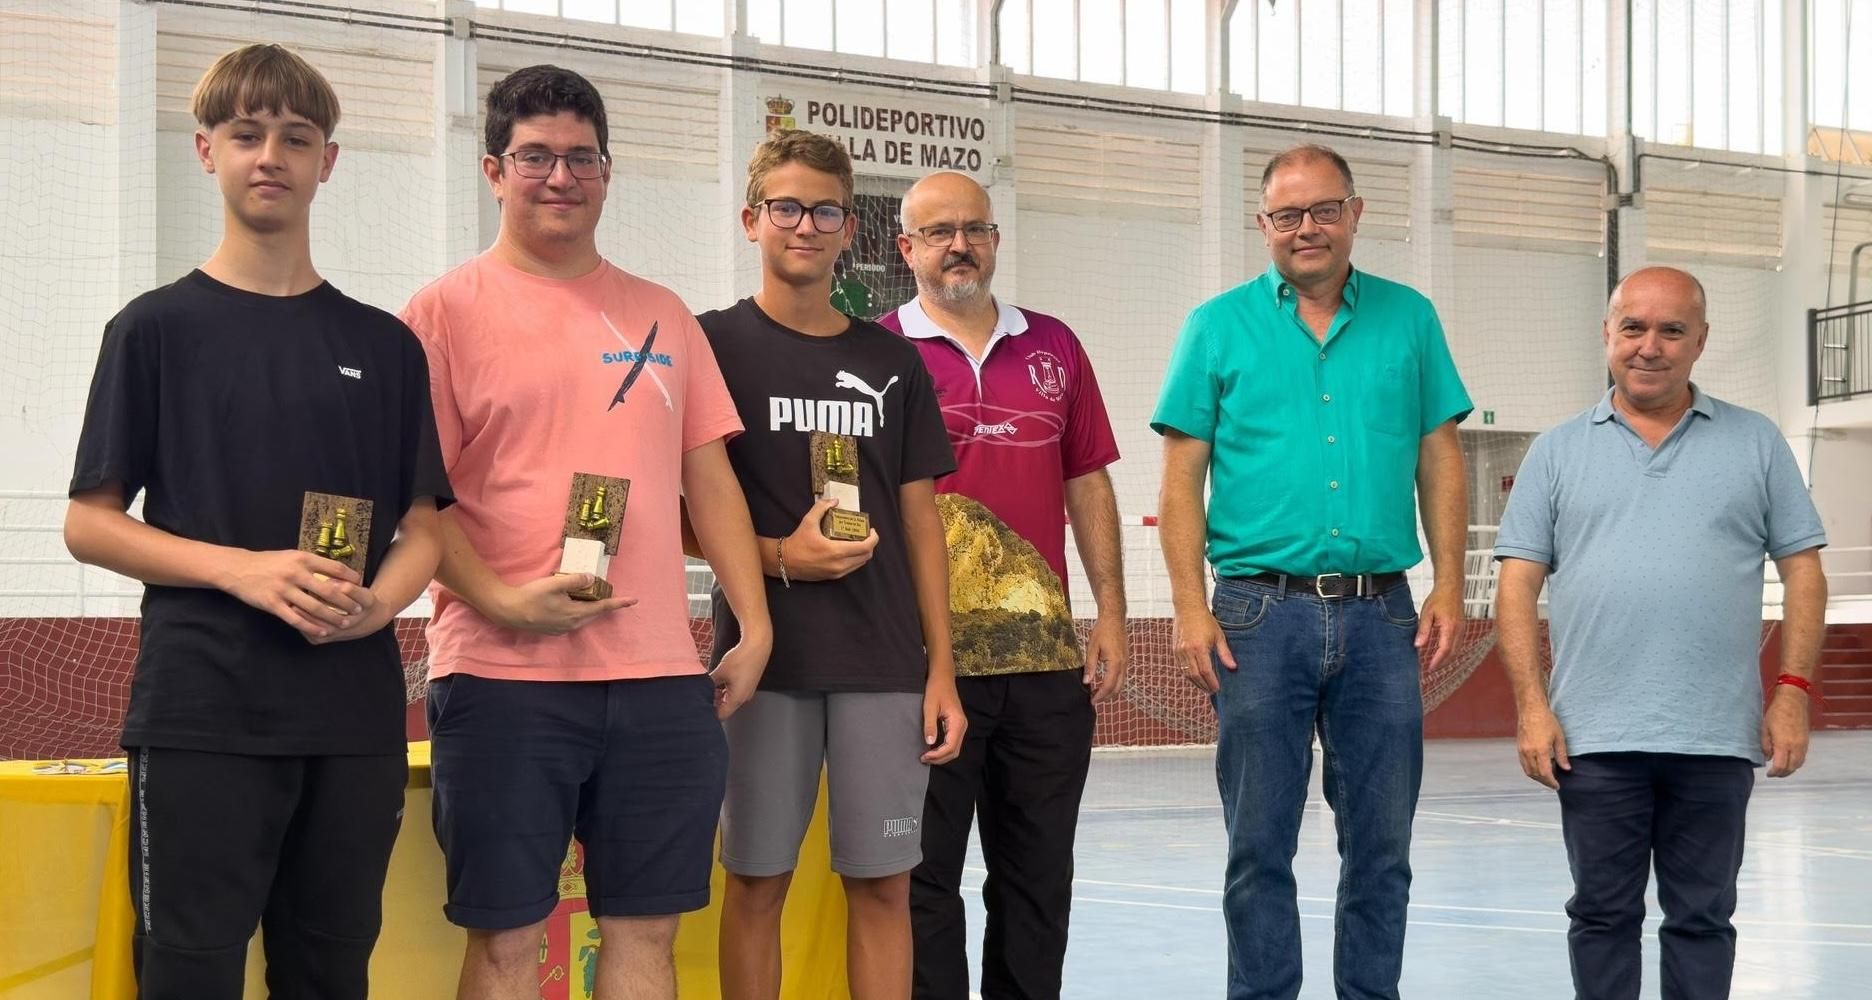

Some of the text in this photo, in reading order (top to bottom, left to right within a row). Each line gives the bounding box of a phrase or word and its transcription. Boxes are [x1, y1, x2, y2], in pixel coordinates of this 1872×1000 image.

[808, 101, 985, 142] POLIDEPORTIVO
[885, 141, 913, 165] DE
[921, 144, 982, 172] MAZO
[338, 365, 362, 379] VANS
[769, 396, 873, 437] PUMA
